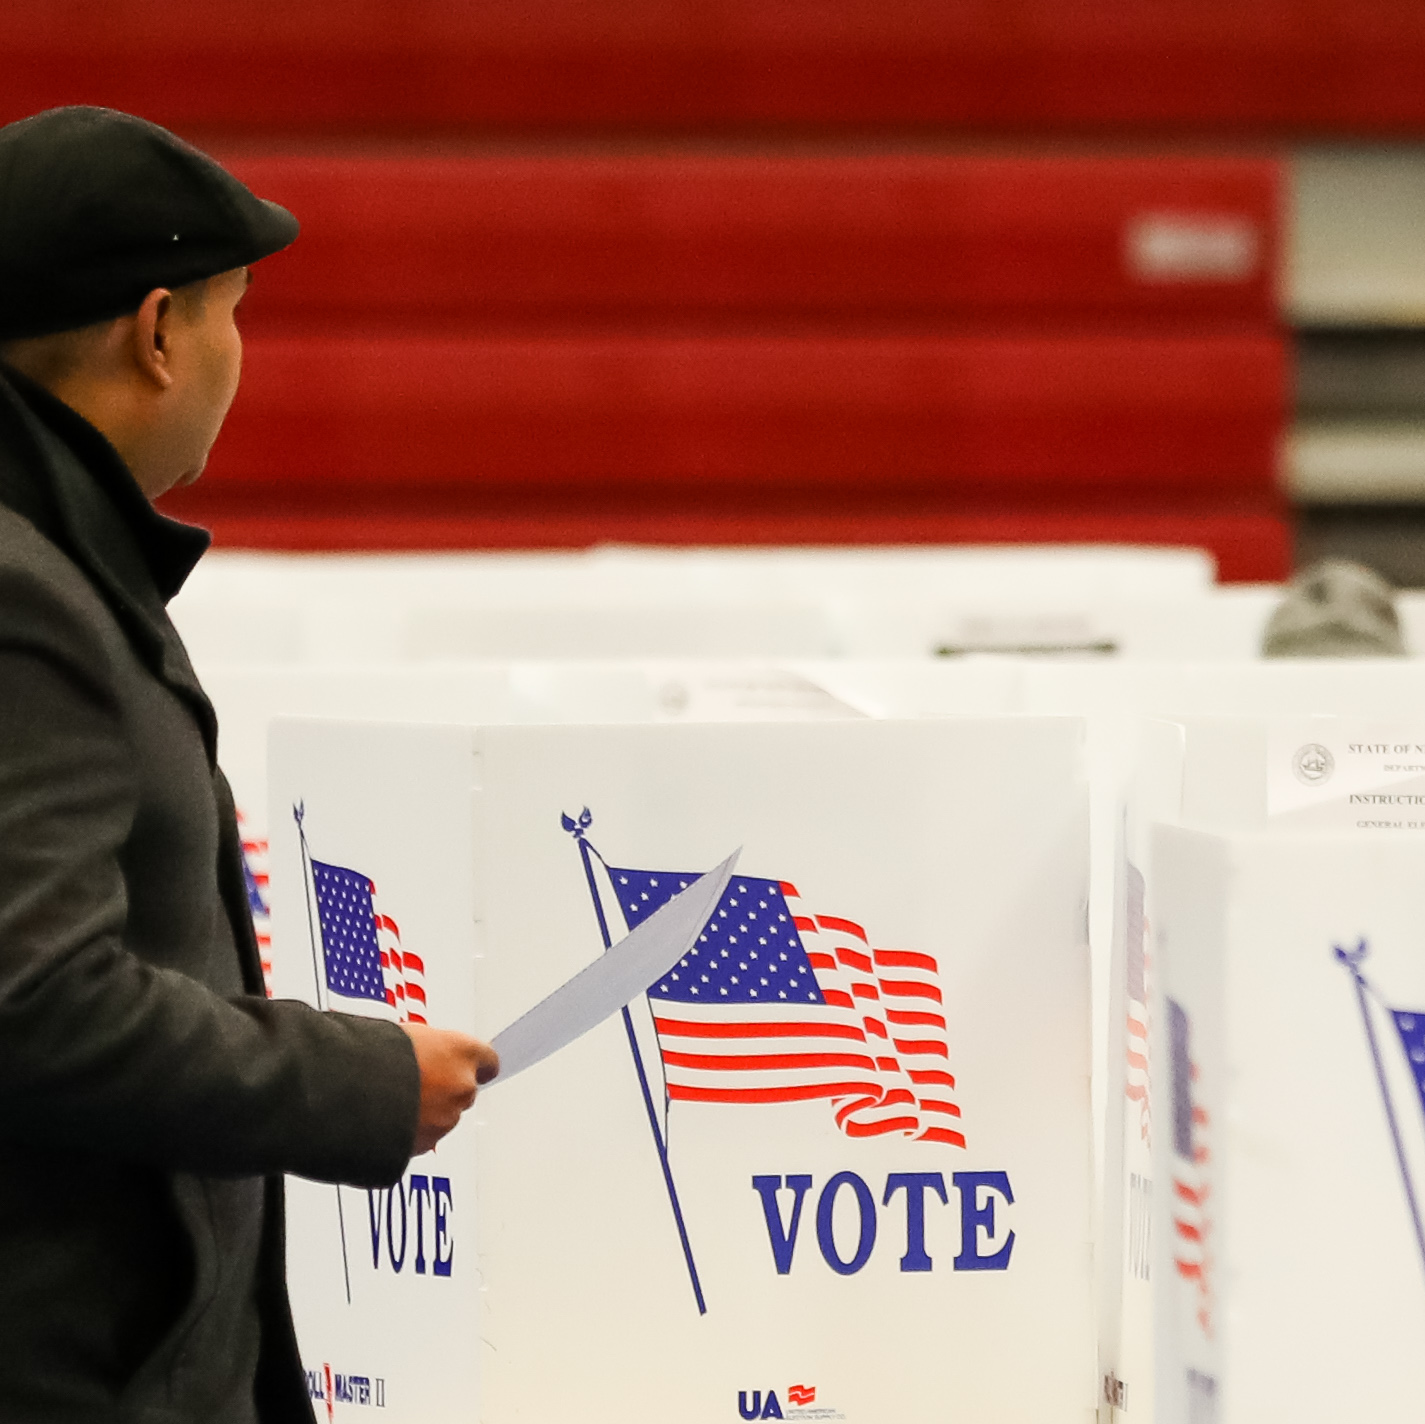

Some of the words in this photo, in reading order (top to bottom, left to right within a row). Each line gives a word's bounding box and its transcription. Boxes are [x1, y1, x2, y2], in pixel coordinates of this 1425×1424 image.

[1348, 743, 1391, 755] STATE
[1393, 744, 1410, 755] OF
[367, 1174, 453, 1277] VOTE
[751, 1170, 1016, 1276] VOTE
[303, 1370, 324, 1400] OLL
[334, 1373, 371, 1405] MASTER
[737, 1389, 784, 1421] UA
